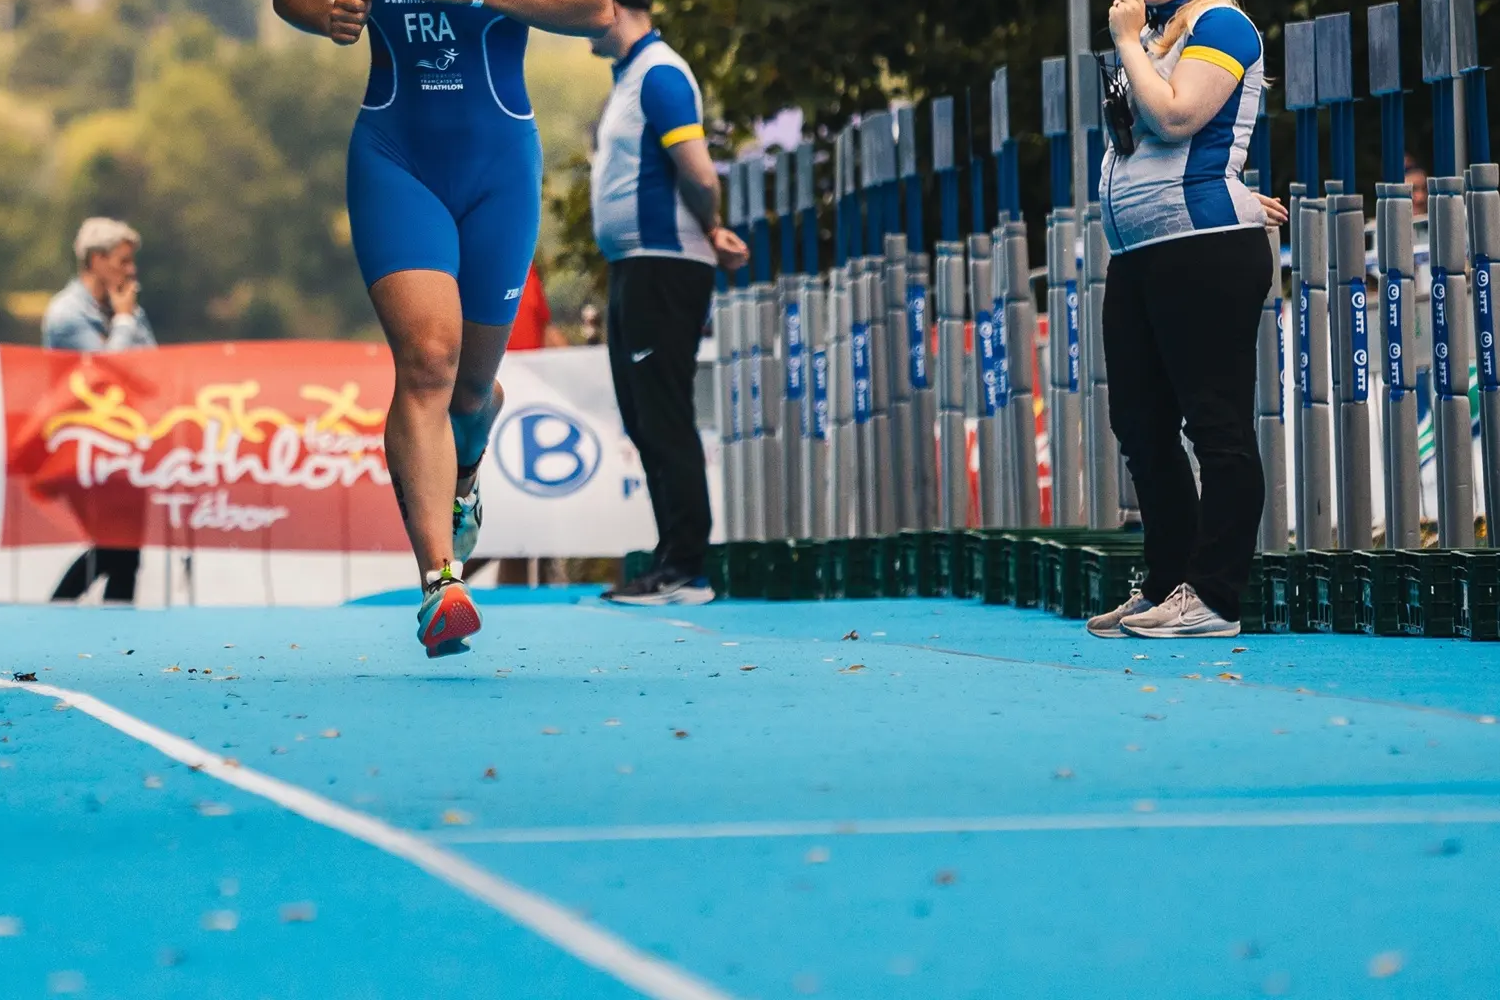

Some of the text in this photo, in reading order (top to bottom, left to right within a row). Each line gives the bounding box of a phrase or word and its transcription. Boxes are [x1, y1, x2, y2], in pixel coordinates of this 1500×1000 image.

[404, 11, 456, 43] FRA
[420, 83, 464, 91] TRIATHLON
[1389, 303, 1398, 327] NTT
[1480, 290, 1488, 315] NTT
[1355, 311, 1365, 334] NTT
[1391, 361, 1400, 386] NTT
[1483, 351, 1492, 376] NTT
[1357, 368, 1366, 392] NTT
[47, 418, 392, 489] Triathlon
